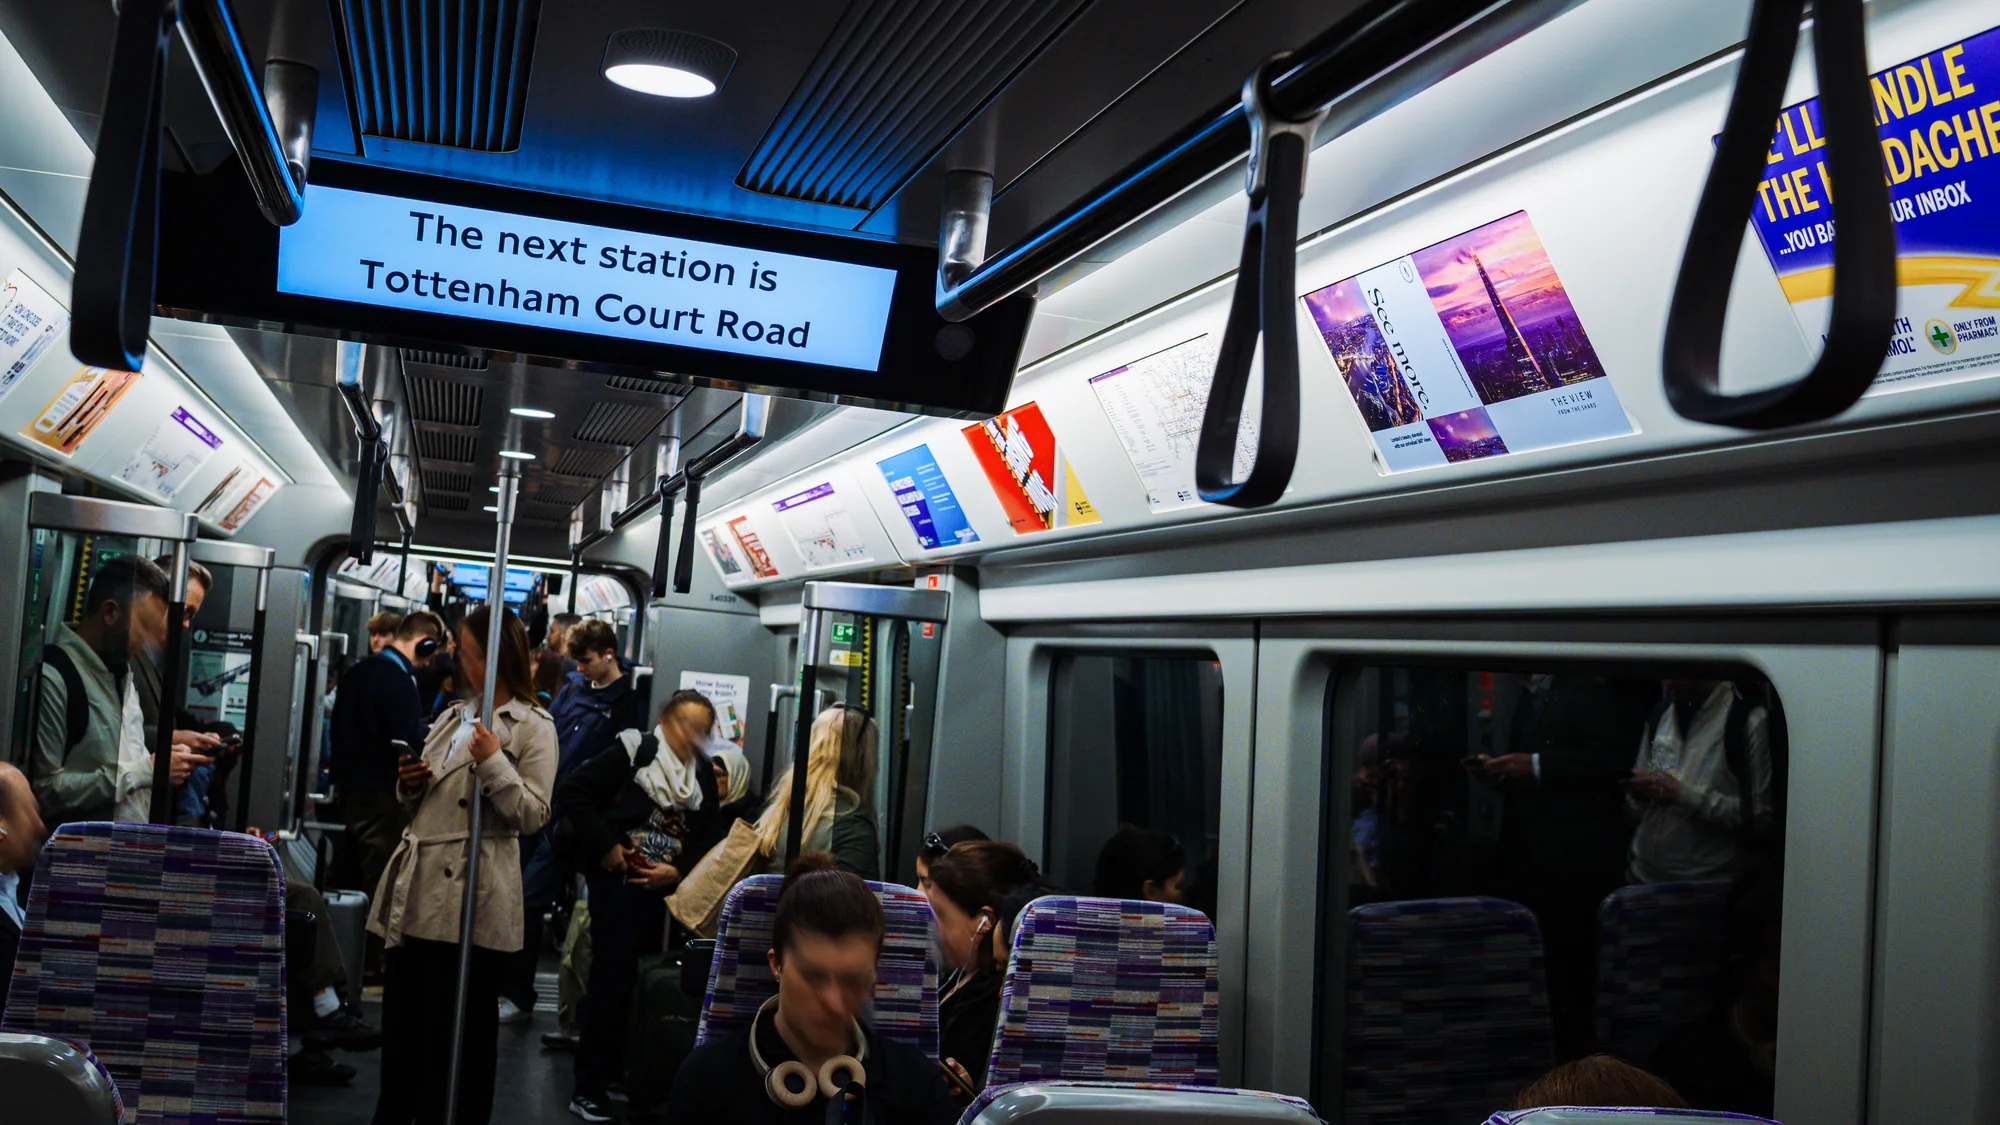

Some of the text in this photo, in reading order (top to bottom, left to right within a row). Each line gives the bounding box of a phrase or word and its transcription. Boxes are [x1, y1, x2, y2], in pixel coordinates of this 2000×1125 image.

[1870, 44, 1975, 127] NDLE
[1756, 167, 1820, 223] THE
[1889, 180, 1972, 223] UR INBOX
[410, 211, 778, 293] The next station is
[1780, 226, 1816, 255] ...YOU
[360, 259, 811, 349] Tottenham Court Road
[1953, 316, 1997, 332] ONLY FROM
[1367, 288, 1430, 410] See more.
[1957, 327, 1999, 342] PHARMACY
[1551, 390, 1593, 407] THE VIEW
